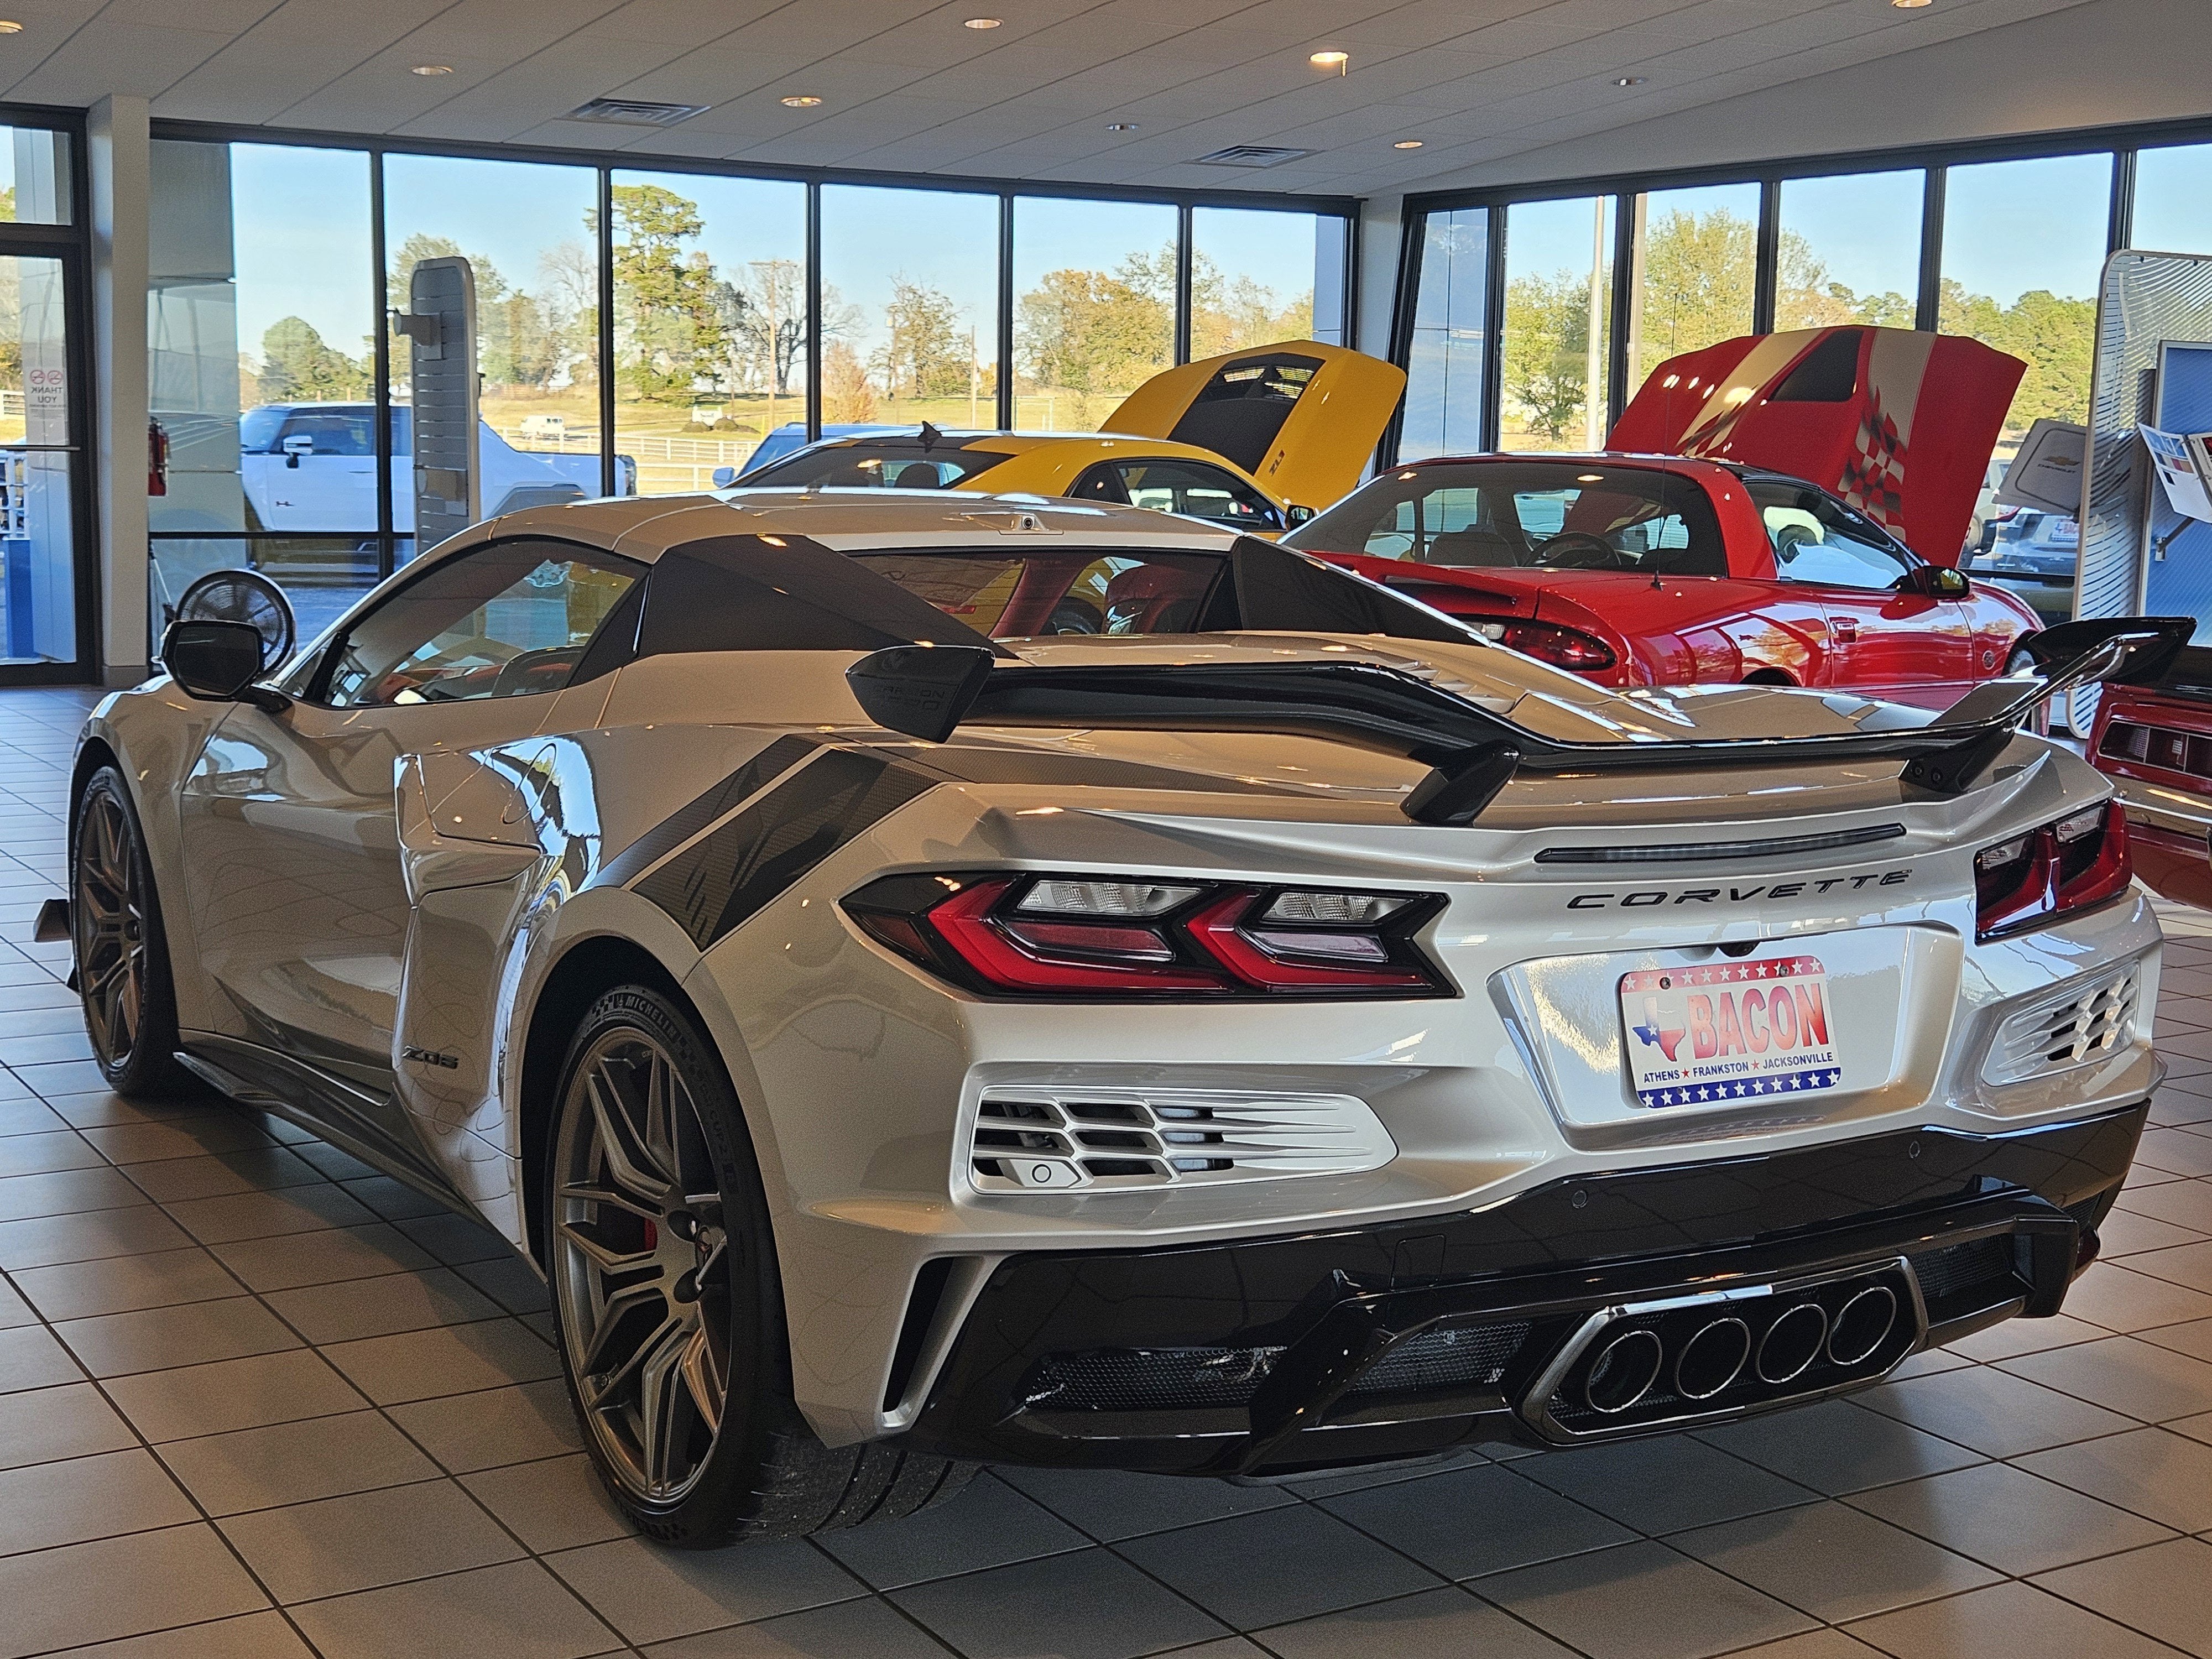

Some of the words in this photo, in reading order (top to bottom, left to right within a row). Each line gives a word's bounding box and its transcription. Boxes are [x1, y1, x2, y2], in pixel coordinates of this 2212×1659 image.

[1566, 869, 1913, 909] CORVETTE
[625, 995, 676, 1038] MICHELIN
[1688, 983, 1829, 1059] BACON
[402, 1045, 459, 1069] Z06
[1643, 1069, 1681, 1084] ATHENS
[1693, 1062, 1749, 1077] FRANKSTON
[1762, 1052, 1833, 1068] JACKSONVILLE
